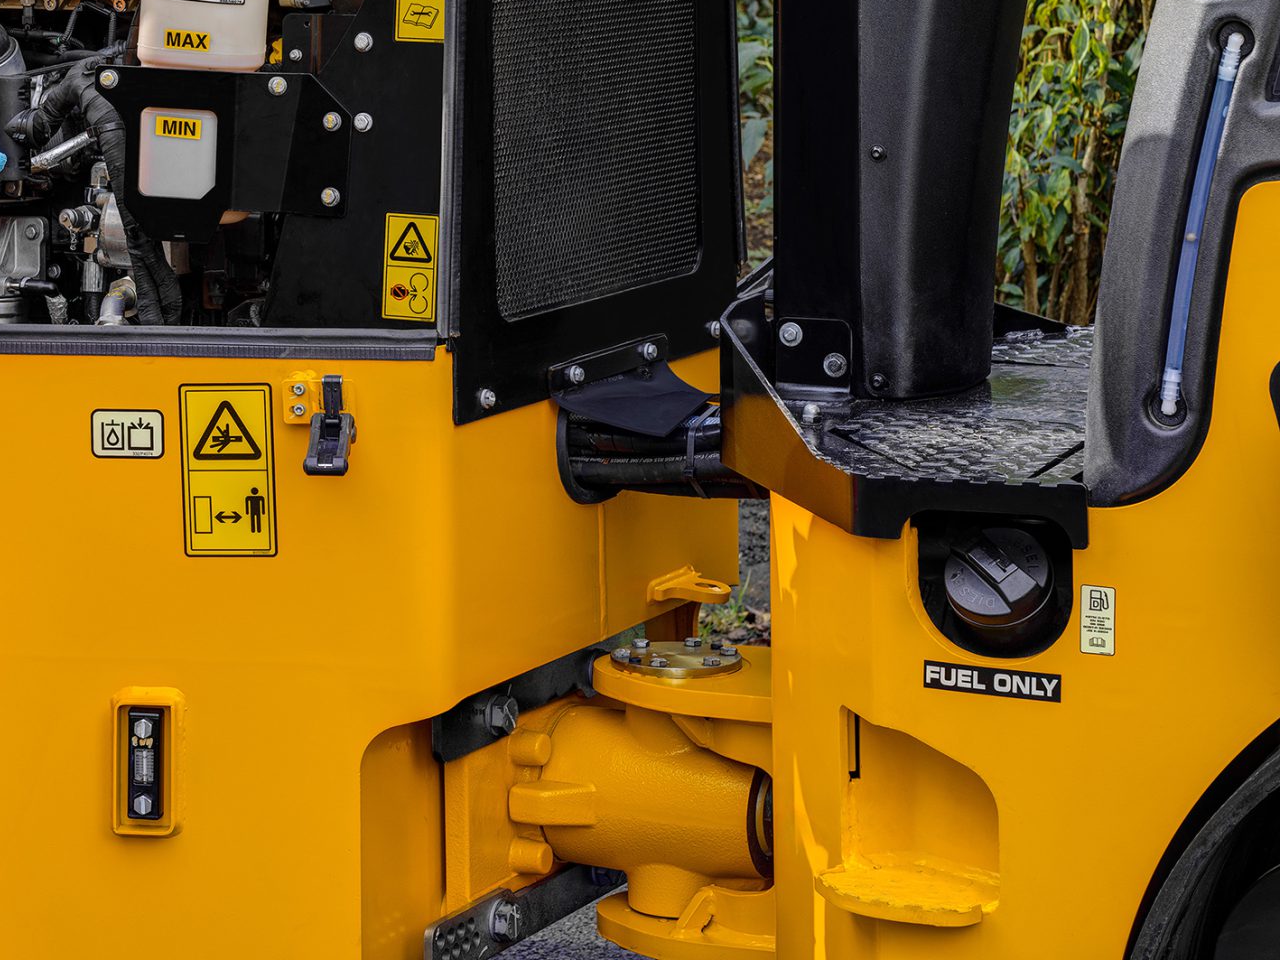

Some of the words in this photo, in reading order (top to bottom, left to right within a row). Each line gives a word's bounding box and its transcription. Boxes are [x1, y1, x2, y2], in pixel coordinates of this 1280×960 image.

[166, 31, 208, 49] MAX
[162, 120, 196, 136] MIN
[1092, 600, 1100, 608] D
[926, 665, 986, 690] FUEL
[993, 673, 1059, 697] ONLY
